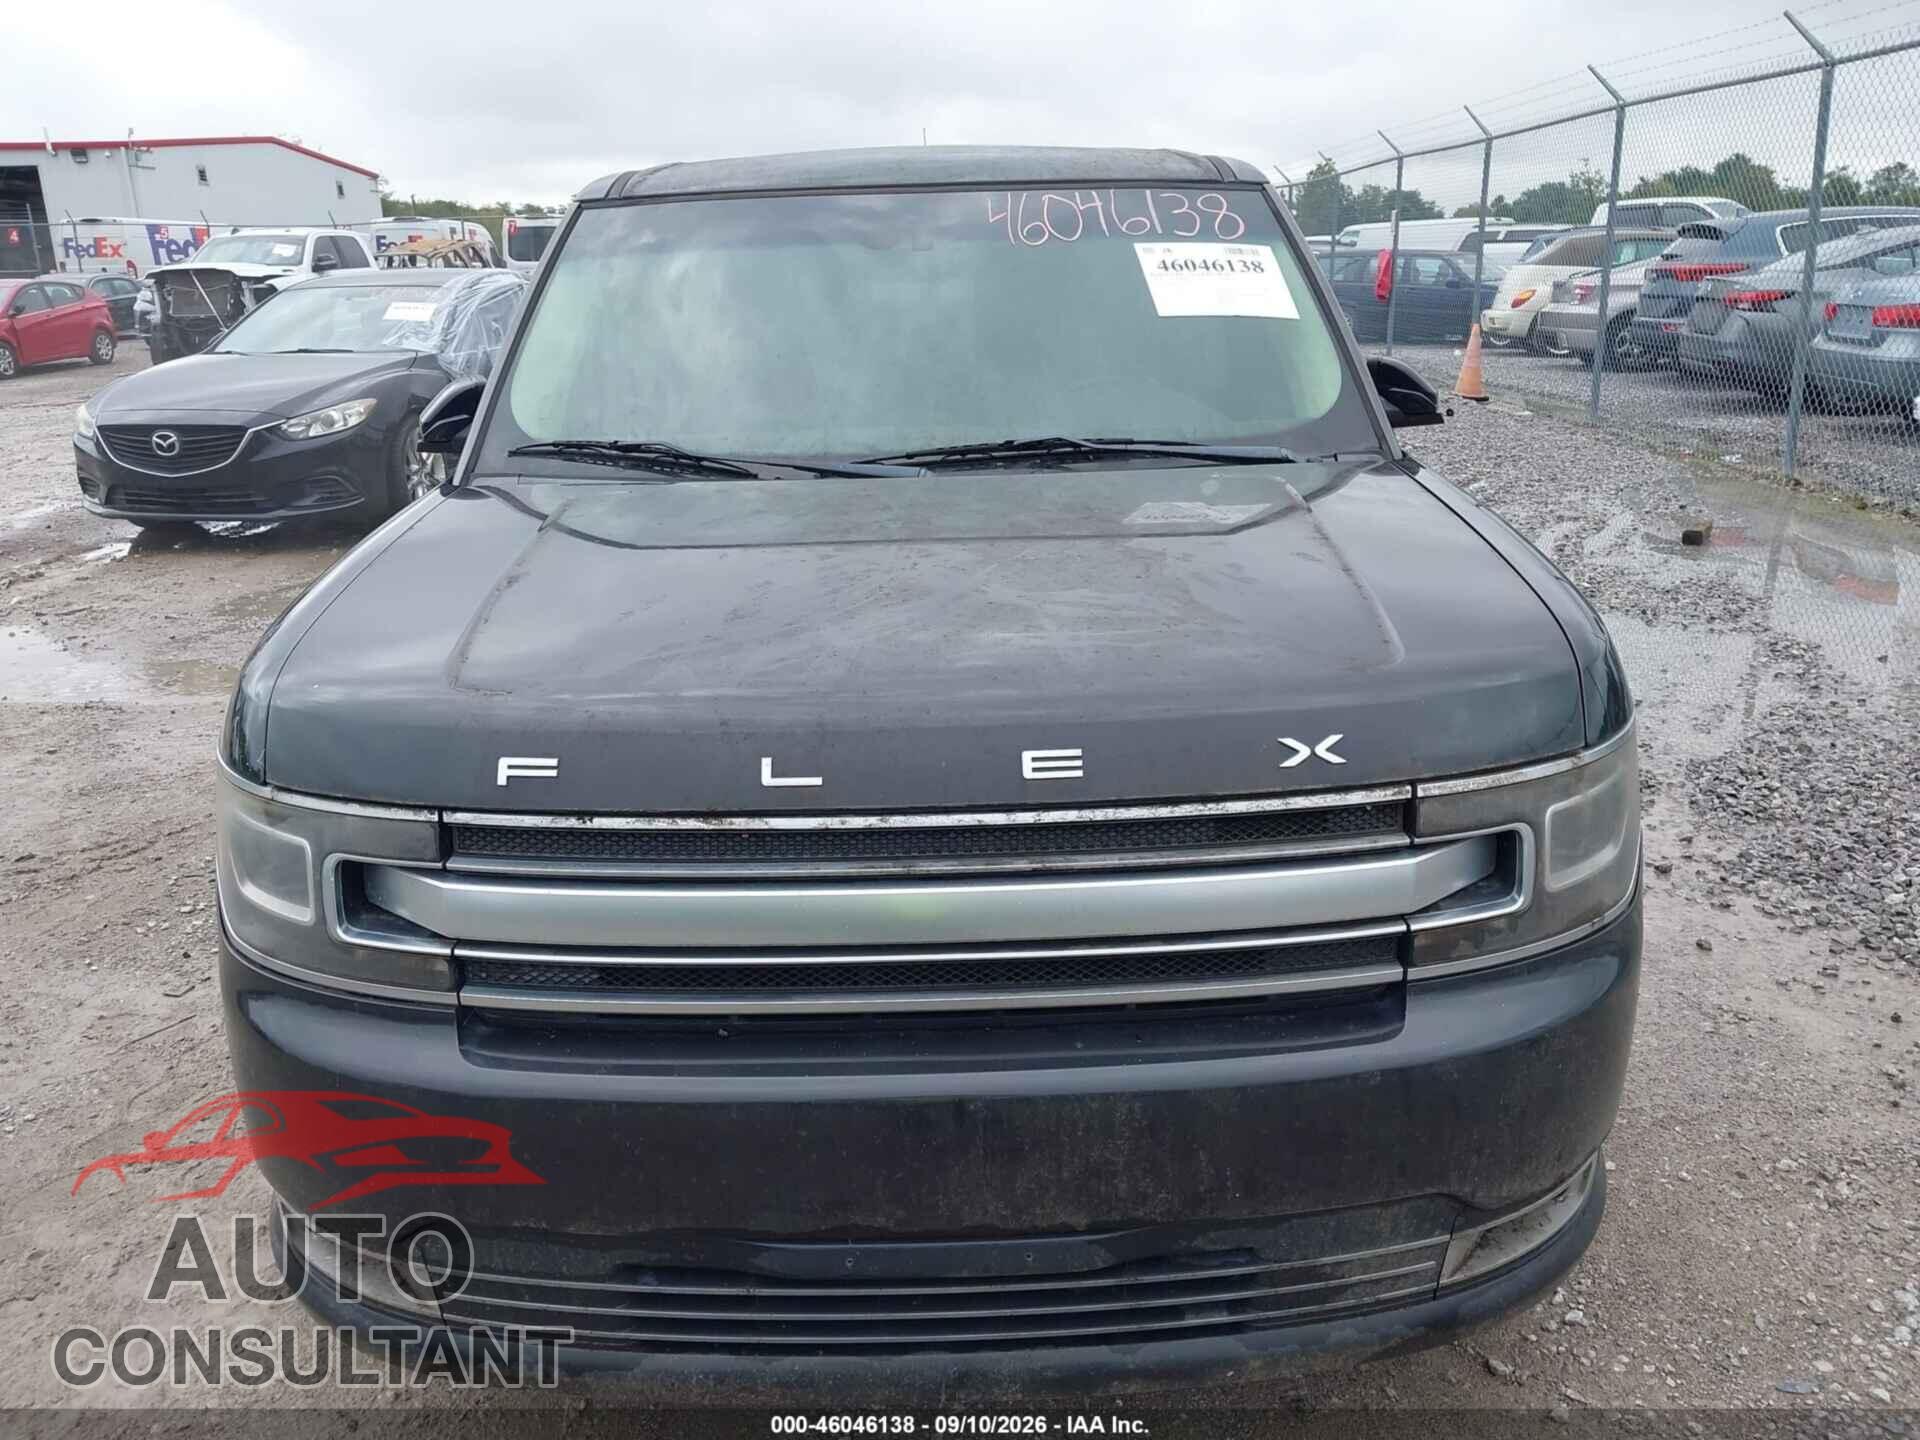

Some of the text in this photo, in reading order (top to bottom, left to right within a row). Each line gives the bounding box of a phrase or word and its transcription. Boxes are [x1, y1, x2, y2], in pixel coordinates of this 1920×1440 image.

[987, 188, 1245, 246] 46046138
[63, 237, 123, 259] FedEx
[1156, 258, 1265, 274] 46046138
